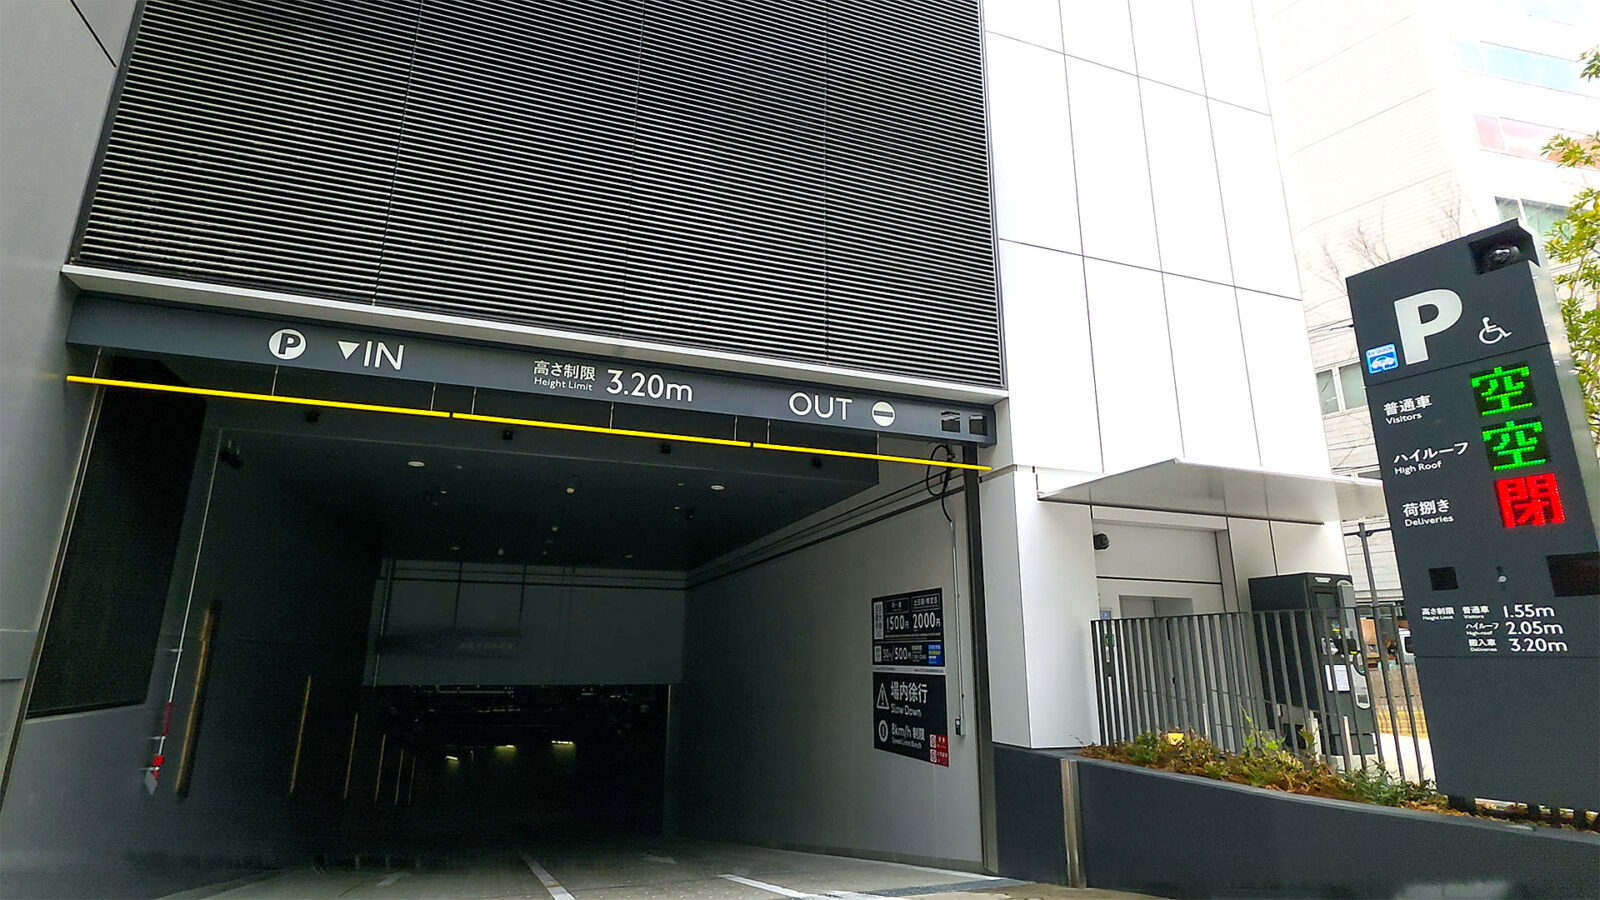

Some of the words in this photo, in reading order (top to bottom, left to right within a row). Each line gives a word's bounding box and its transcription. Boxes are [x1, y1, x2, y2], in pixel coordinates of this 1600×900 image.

[1394, 289, 1462, 366] P
[363, 340, 405, 371] IN
[534, 360, 596, 381] 高さ制限
[606, 369, 693, 402] 3.20m
[534, 377, 566, 389] Height
[568, 380, 593, 392] Limit
[1471, 366, 1533, 416] 空
[788, 391, 853, 421] OUT
[1383, 395, 1433, 416] 普通車
[1385, 413, 1423, 425] Visitors
[1393, 442, 1469, 463] ハイルーフ
[1481, 420, 1547, 471] 空
[1394, 465, 1417, 476] High
[1418, 460, 1443, 471] Roof
[1402, 499, 1450, 517] 荷捌き
[1497, 473, 1565, 528] 閉
[1404, 515, 1454, 527] Deliveries
[1421, 607, 1455, 615] 高さ制限
[1462, 606, 1490, 614] 普通車
[1502, 604, 1556, 619] 1.55m
[1465, 622, 1499, 630] ハイルーフ
[1505, 621, 1564, 636] 2.05m
[1510, 637, 1568, 652] 3.20m
[890, 681, 929, 704] 場内徐行
[890, 703, 904, 715] Slow
[904, 705, 922, 717] Down
[912, 727, 926, 741] 制限
